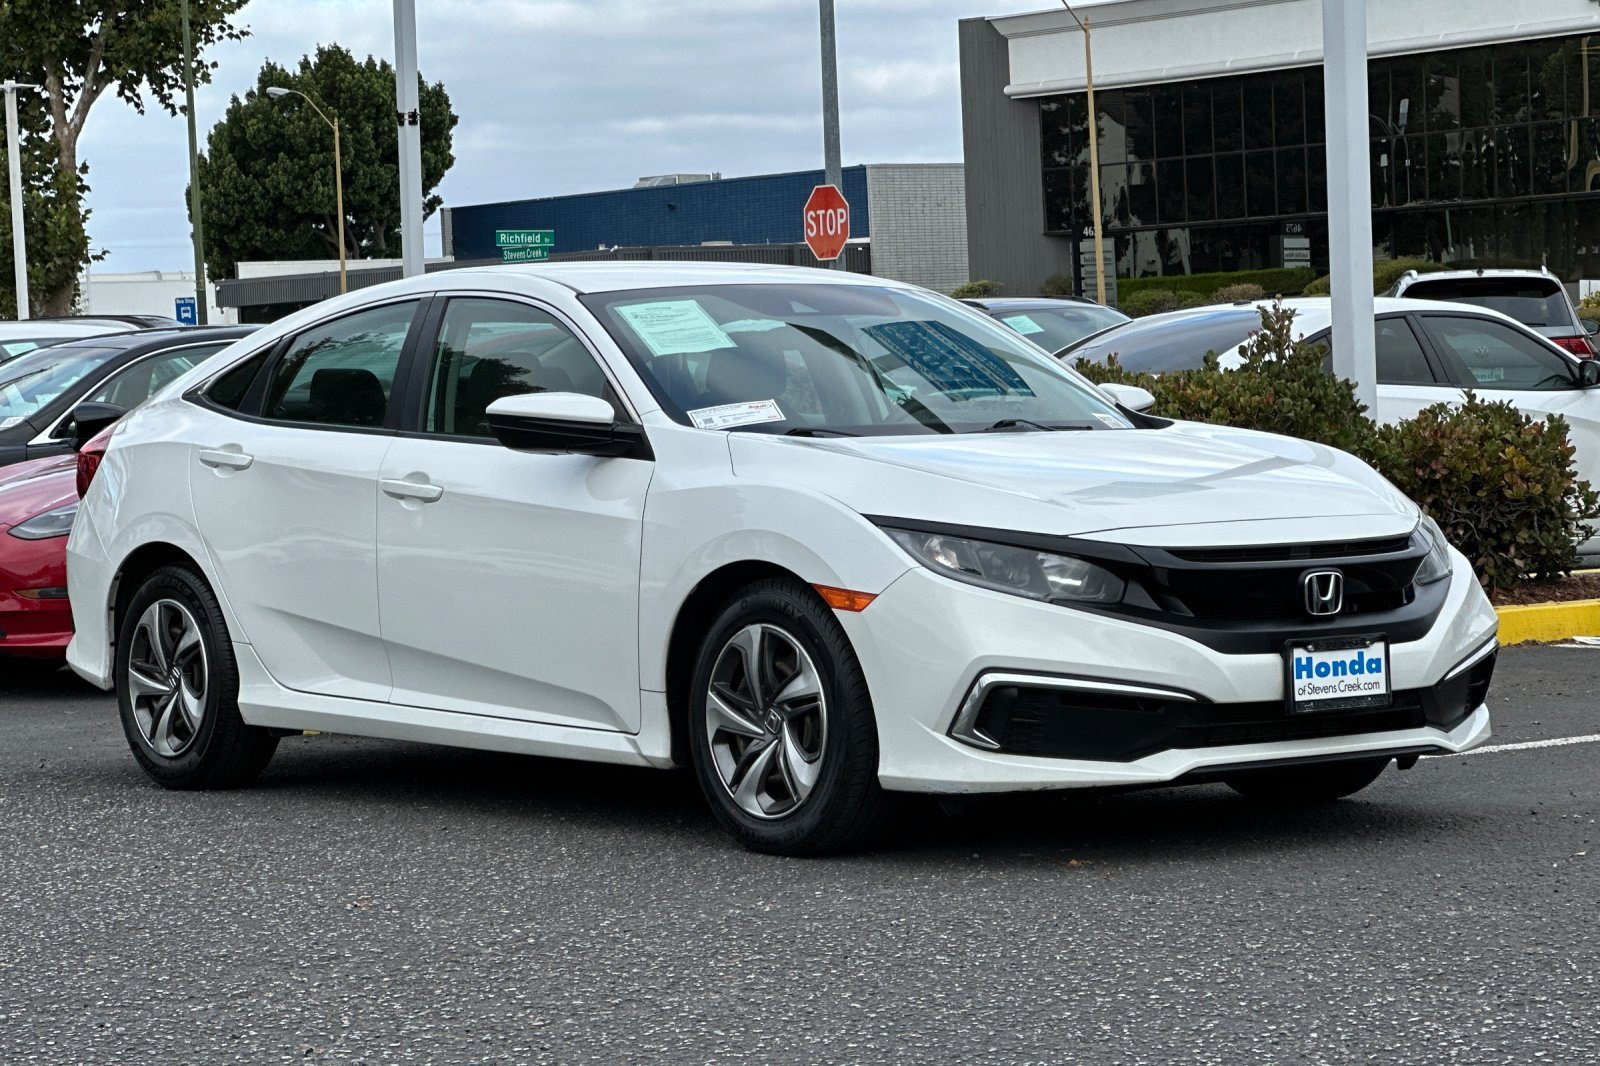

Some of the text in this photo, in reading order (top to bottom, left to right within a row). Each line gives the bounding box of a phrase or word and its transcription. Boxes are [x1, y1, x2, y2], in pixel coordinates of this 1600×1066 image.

[807, 208, 847, 238] STOP
[500, 233, 541, 243] Richfield
[503, 250, 526, 260] Stevens
[526, 248, 543, 258] Creek
[1295, 651, 1382, 680] Honda
[1298, 685, 1307, 696] of
